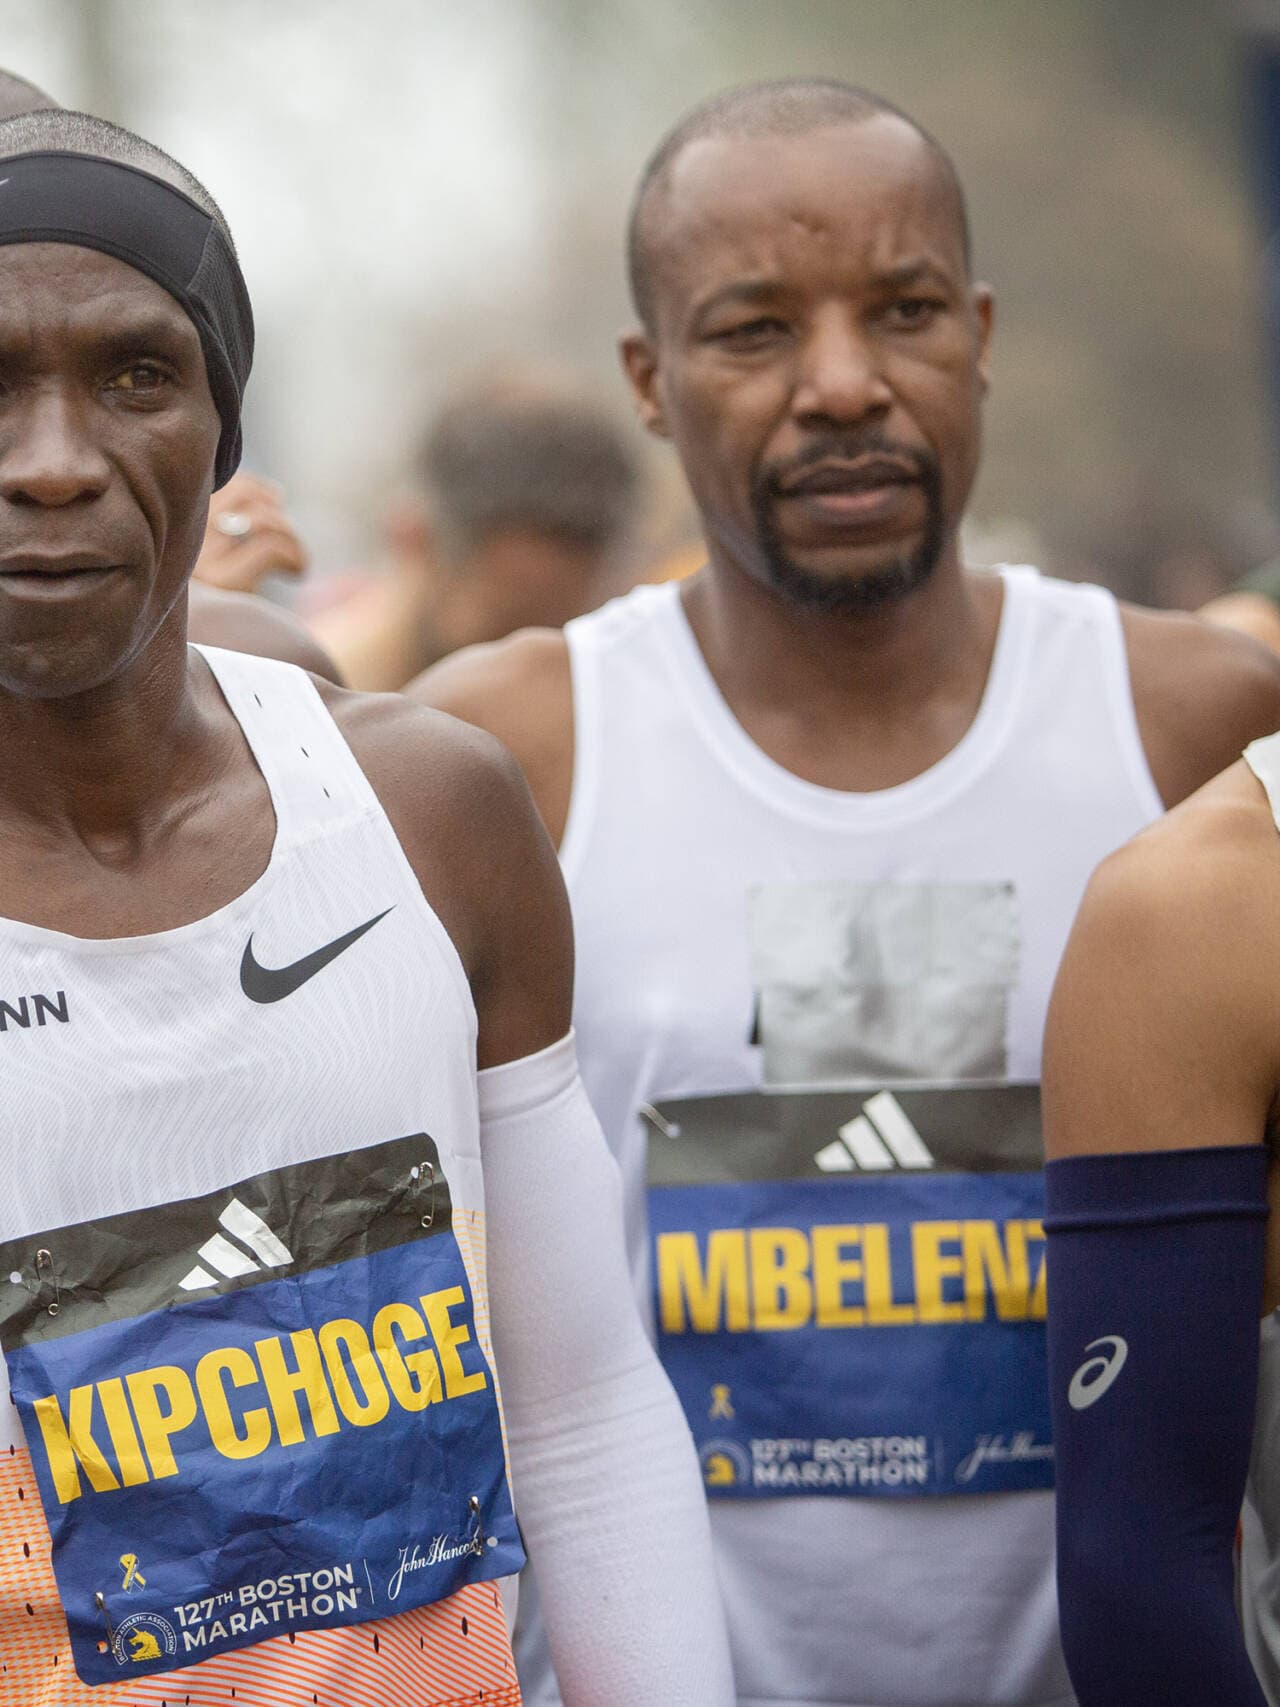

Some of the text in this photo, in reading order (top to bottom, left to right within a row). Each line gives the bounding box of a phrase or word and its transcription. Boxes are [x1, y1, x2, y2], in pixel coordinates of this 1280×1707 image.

[33, 1286, 488, 1505] KIPCHOGE
[753, 1461, 928, 1488] MARATHON
[813, 1436, 927, 1463] BOSTON
[174, 1590, 234, 1627] 127TH
[238, 1563, 355, 1607] BOSTON
[387, 1544, 427, 1601] John
[182, 1587, 358, 1652] MARATHON
